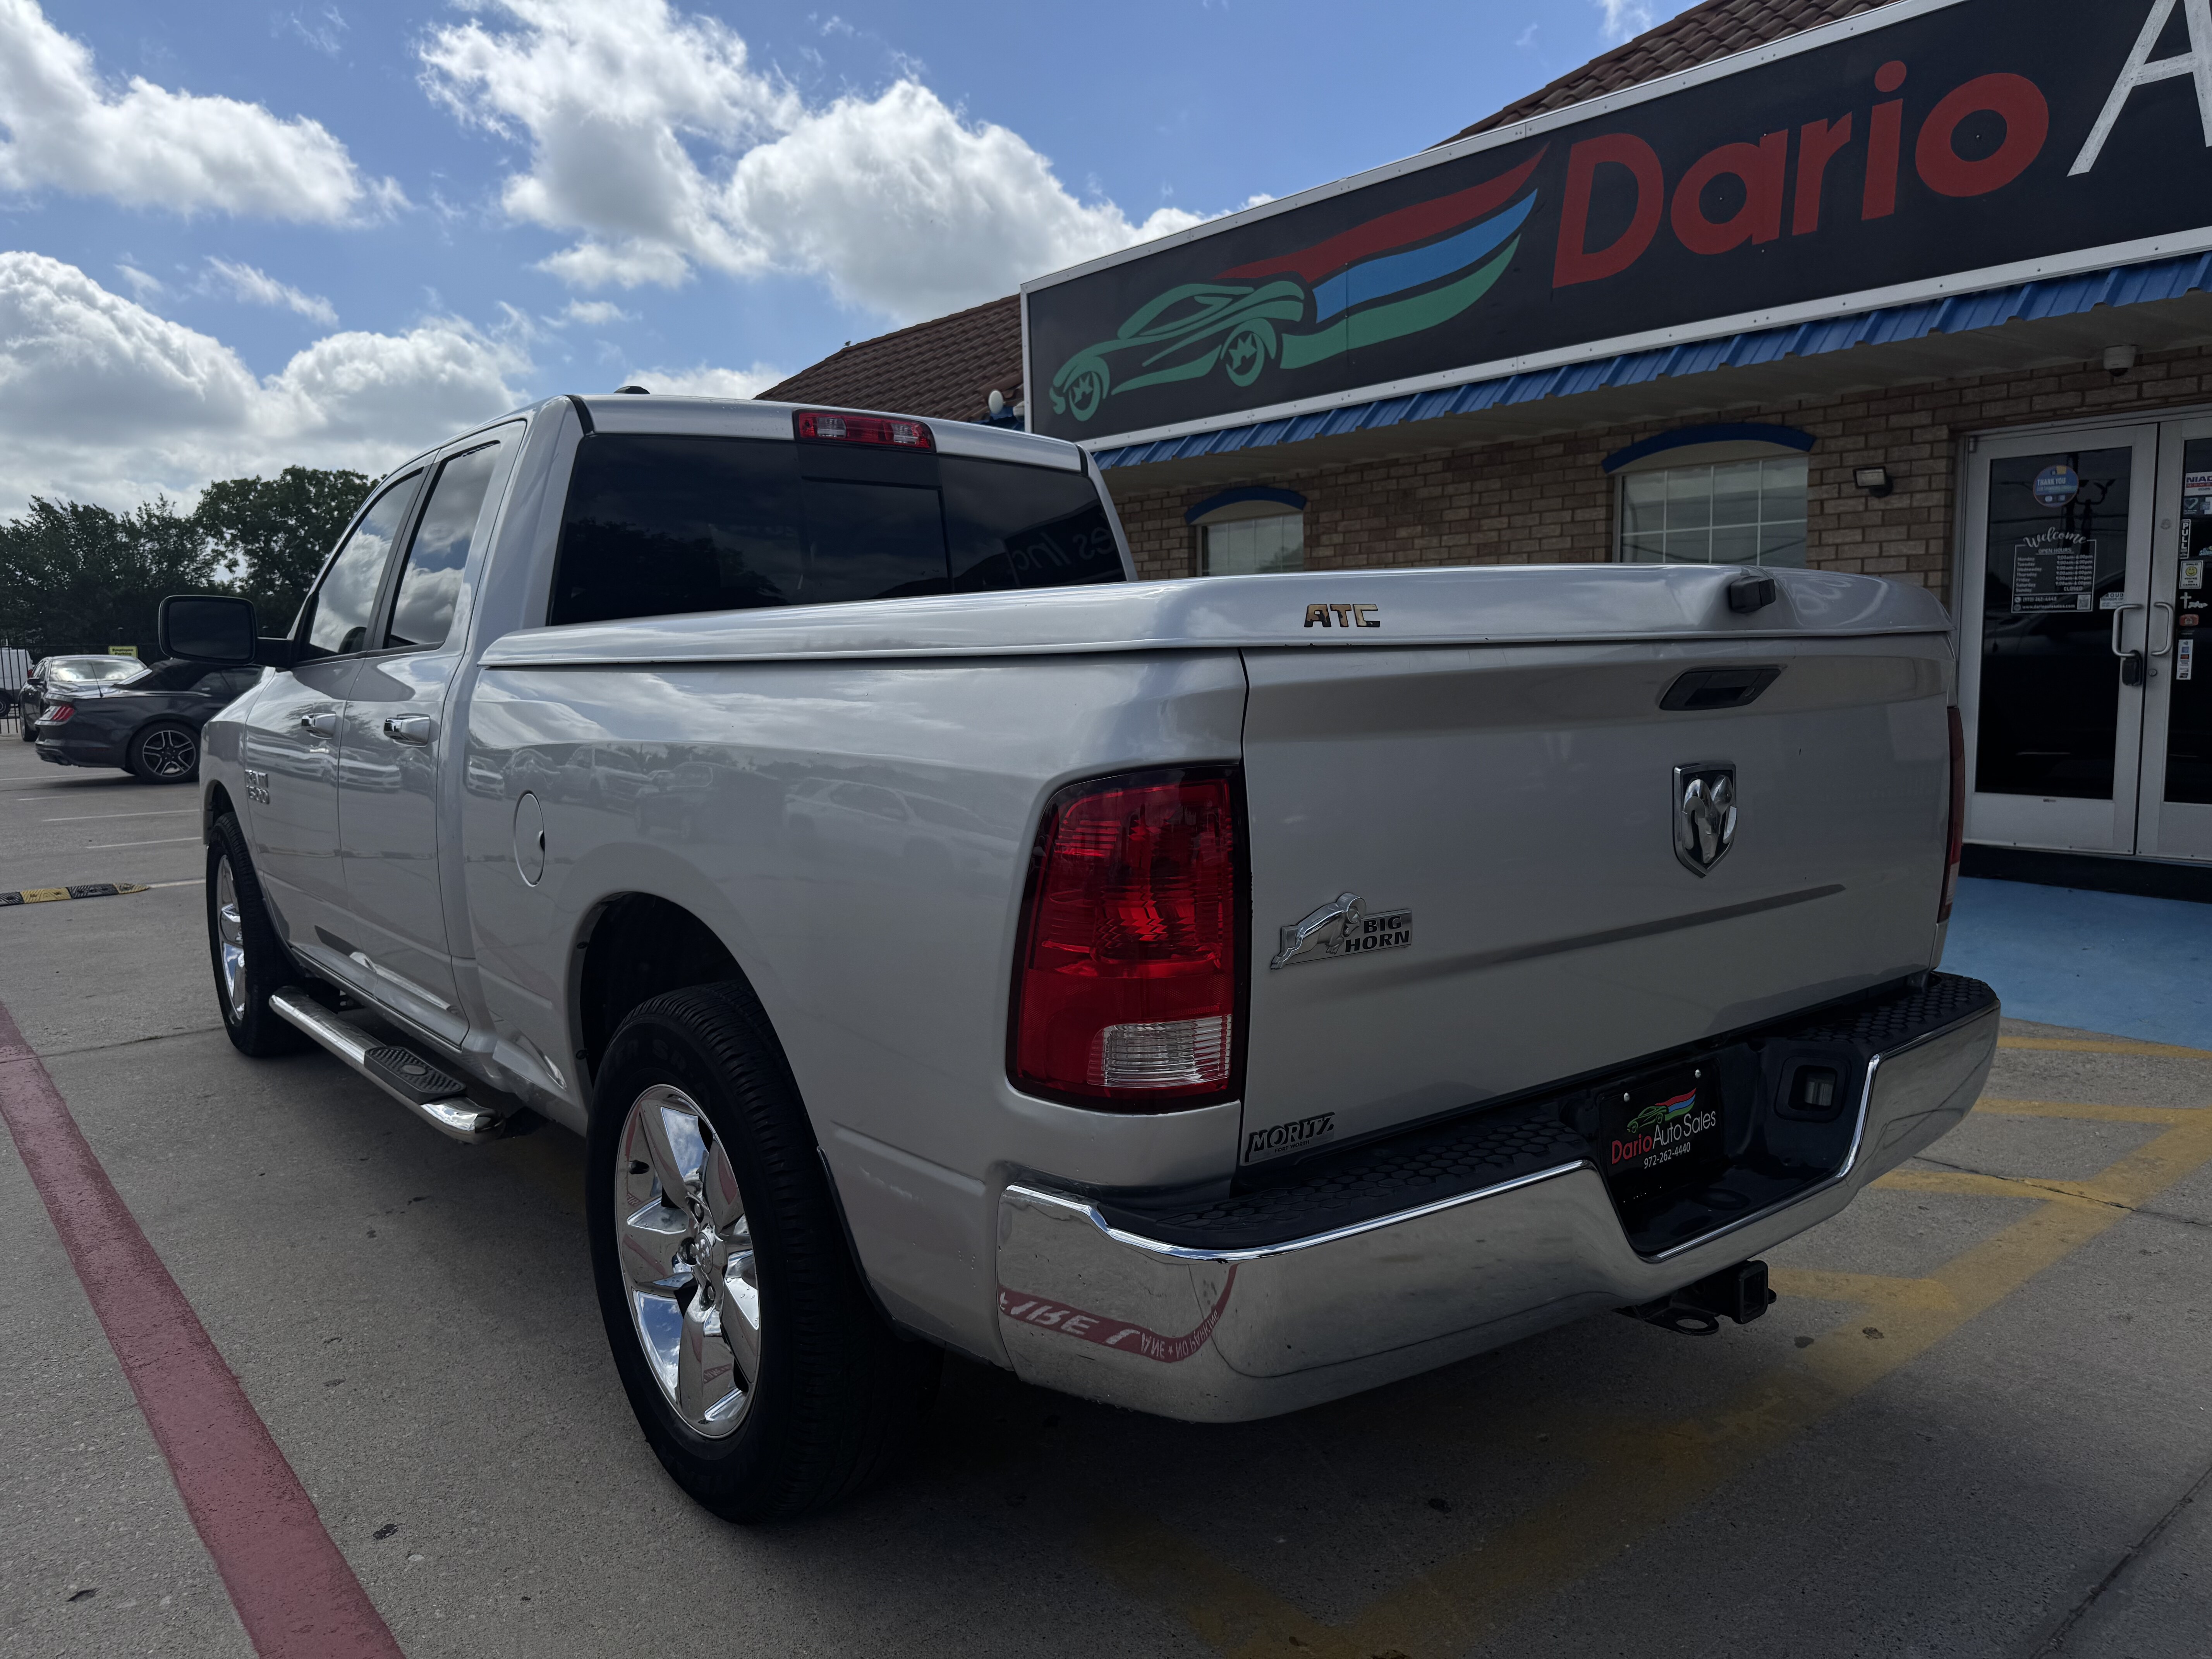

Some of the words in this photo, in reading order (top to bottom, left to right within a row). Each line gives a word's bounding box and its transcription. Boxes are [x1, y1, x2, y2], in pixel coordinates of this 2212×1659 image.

[1553, 60, 2049, 289] Dario
[2023, 526, 2087, 548] Welcome
[1304, 604, 1381, 628] ATC
[1364, 916, 1402, 934] BIG
[1345, 930, 1410, 953] HORN
[1247, 1112, 1335, 1152] MORITZ
[1611, 1133, 1653, 1165] Dario
[1652, 1122, 1682, 1149] Auto
[1683, 1111, 1716, 1137] Sales
[1290, 1140, 1310, 1149] WORTH
[1644, 1142, 1690, 1169] 972-262-4440
